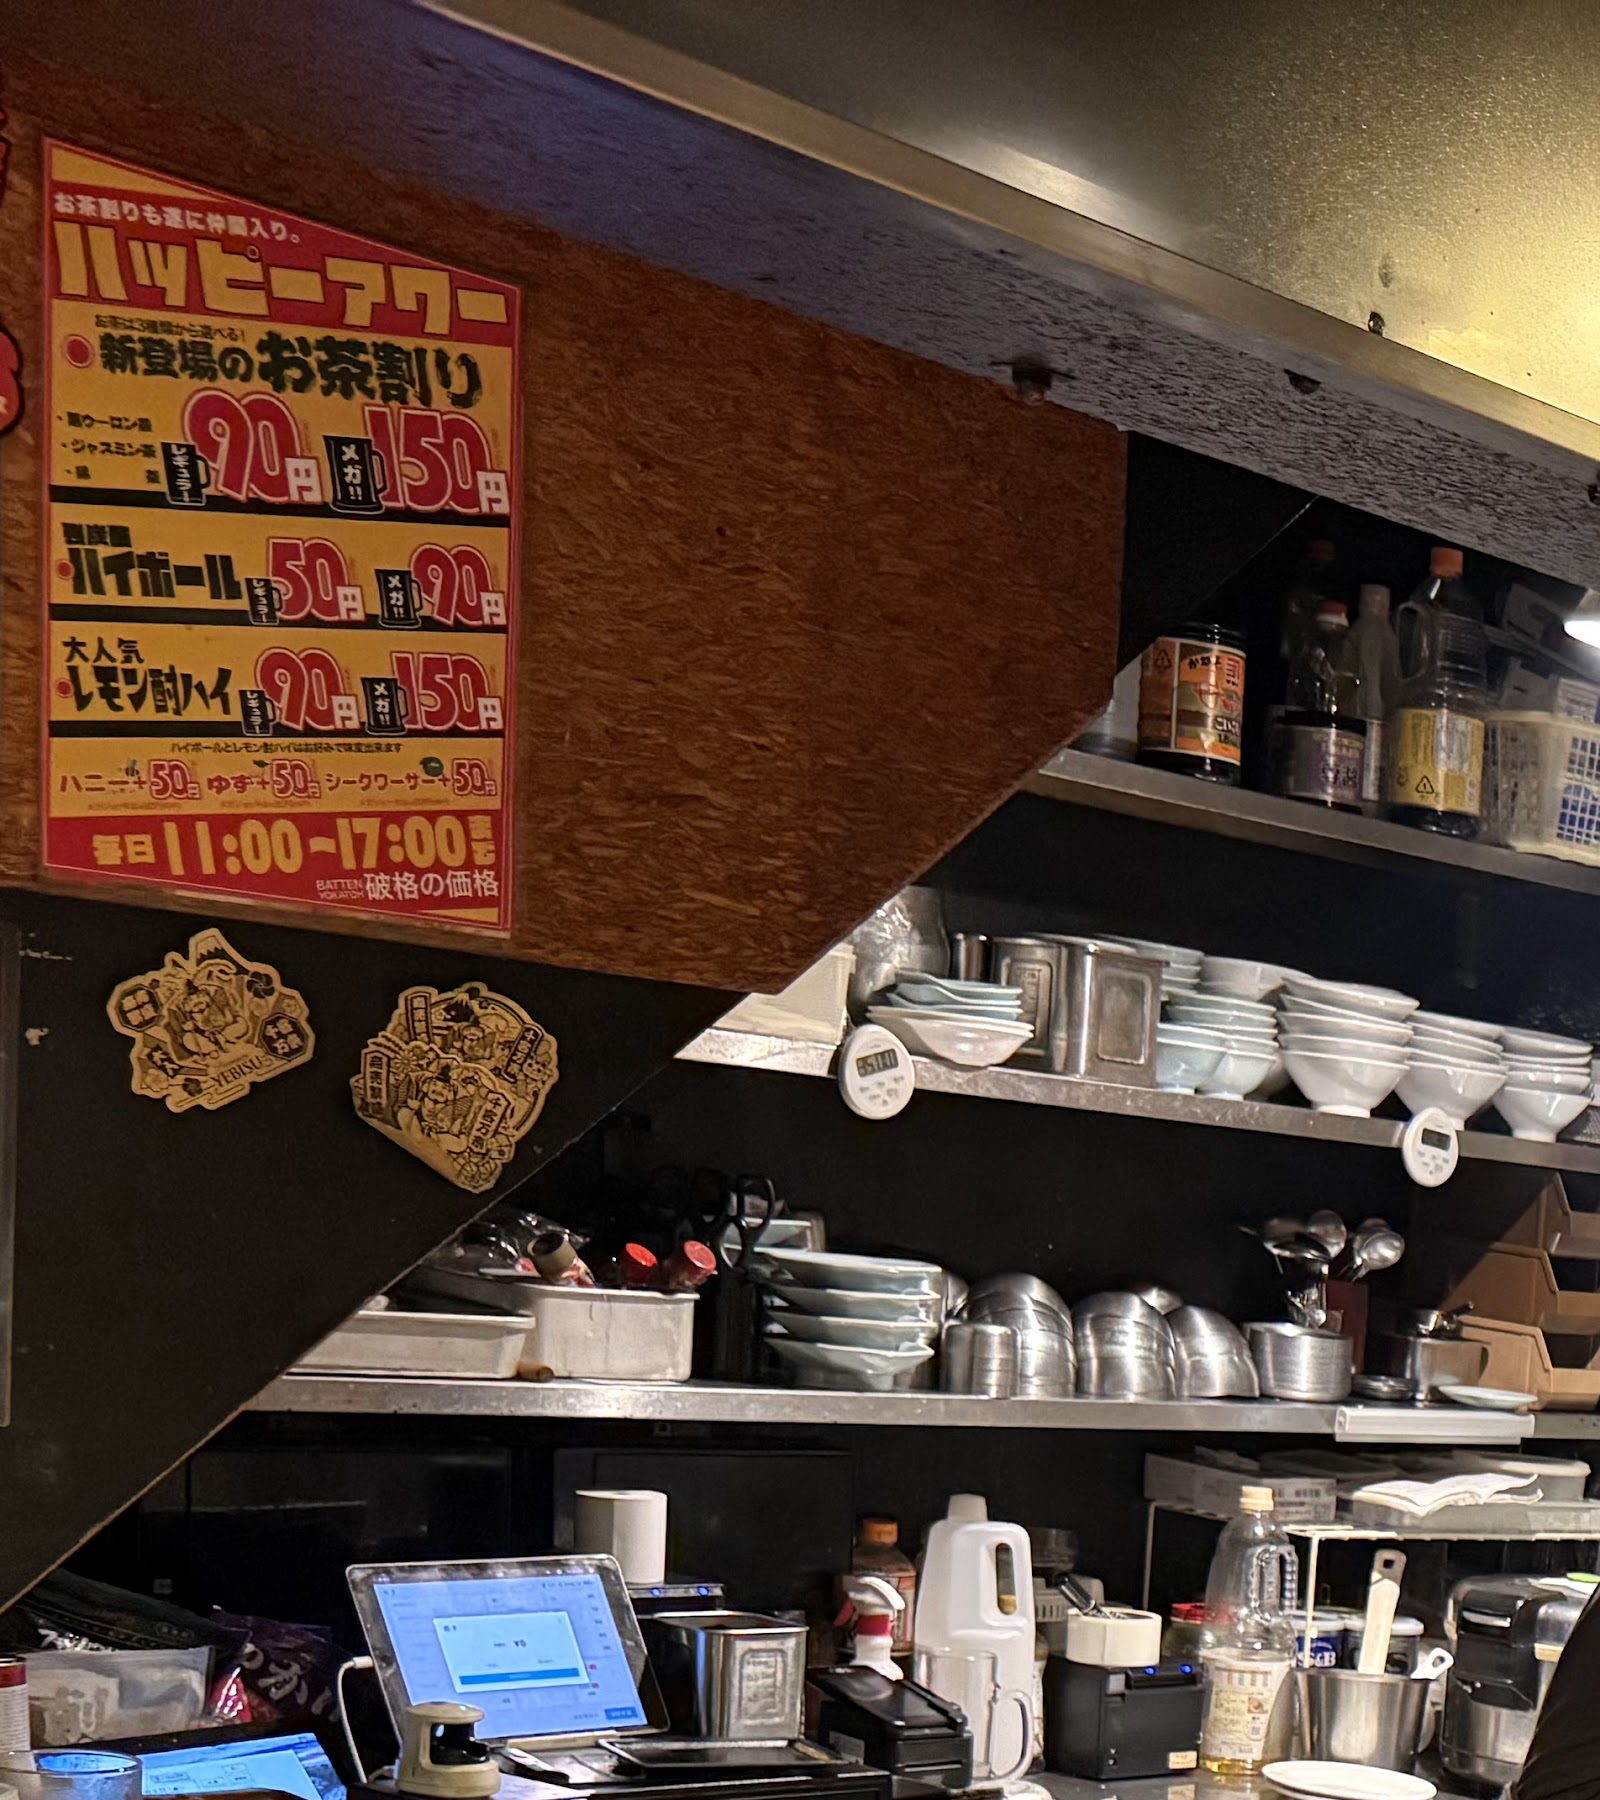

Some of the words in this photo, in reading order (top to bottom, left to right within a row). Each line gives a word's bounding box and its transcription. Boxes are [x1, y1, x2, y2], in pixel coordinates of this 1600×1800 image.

[53, 220, 508, 336] ハッピーアワー
[99, 330, 483, 408] 新登場のお茶割り
[68, 547, 243, 600] ハイボール
[266, 537, 364, 621] 50円
[410, 544, 506, 625] 90円
[62, 637, 144, 664] 大人気
[68, 665, 233, 716] レモン酎ハイ
[255, 647, 360, 731] 90円
[364, 870, 499, 901] 破格の価格
[210, 1056, 263, 1088] YEBISU
[1297, 1650, 1336, 1667] S&B
